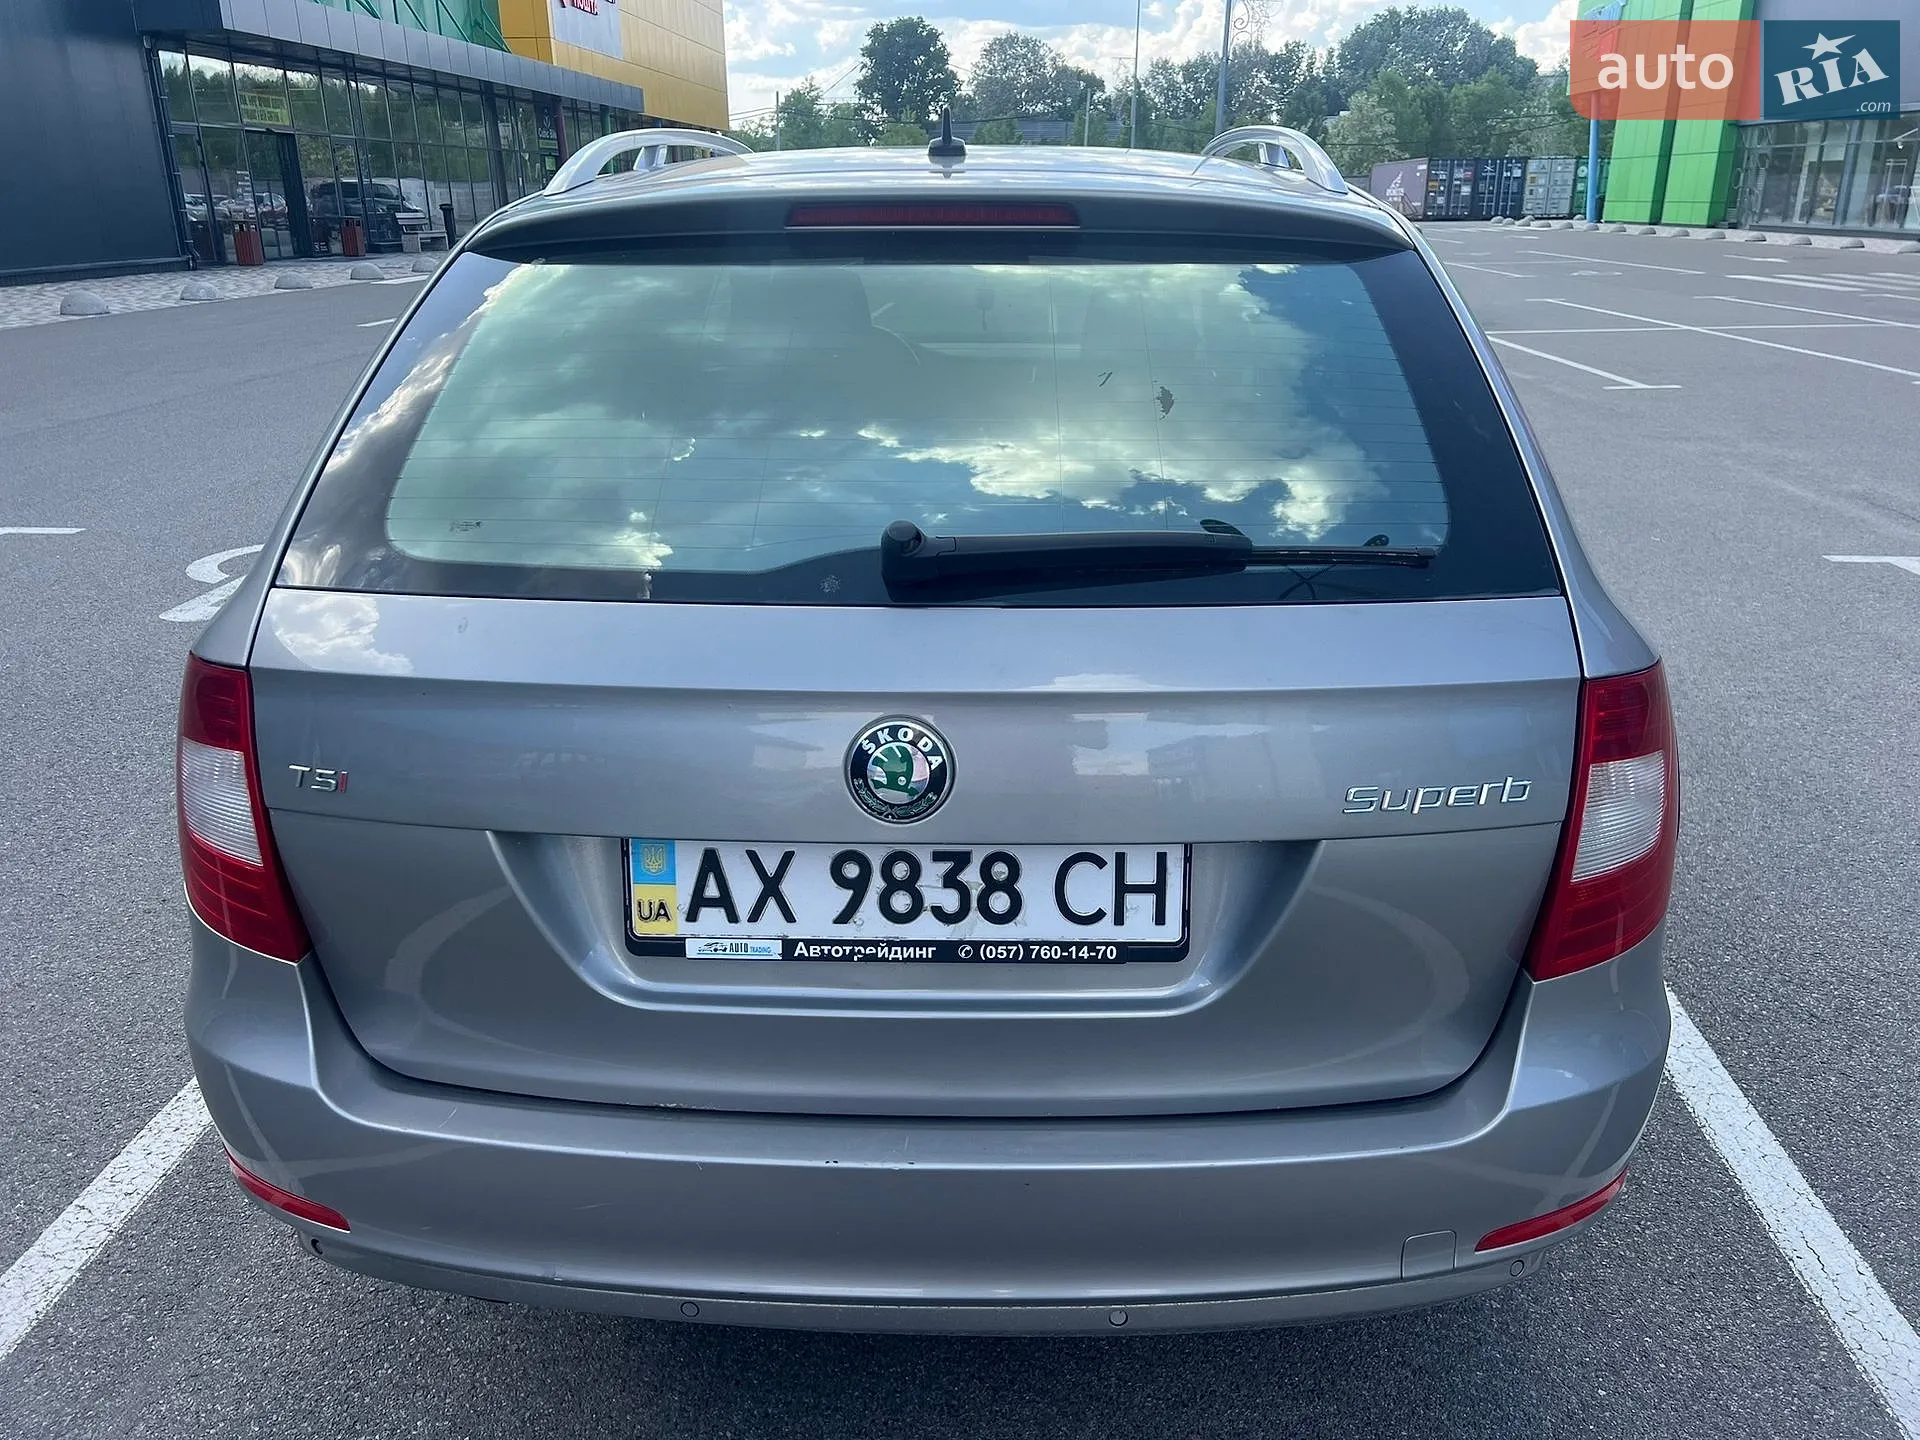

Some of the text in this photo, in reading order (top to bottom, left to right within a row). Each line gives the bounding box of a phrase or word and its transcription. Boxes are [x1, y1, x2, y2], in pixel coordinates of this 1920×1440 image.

[1343, 776, 1532, 814] Superb
[685, 847, 797, 924] AX
[830, 849, 1023, 925] 9838
[637, 899, 671, 922] UA
[729, 943, 749, 953] AUTO
[979, 943, 1118, 961] (057) 760-14-70
